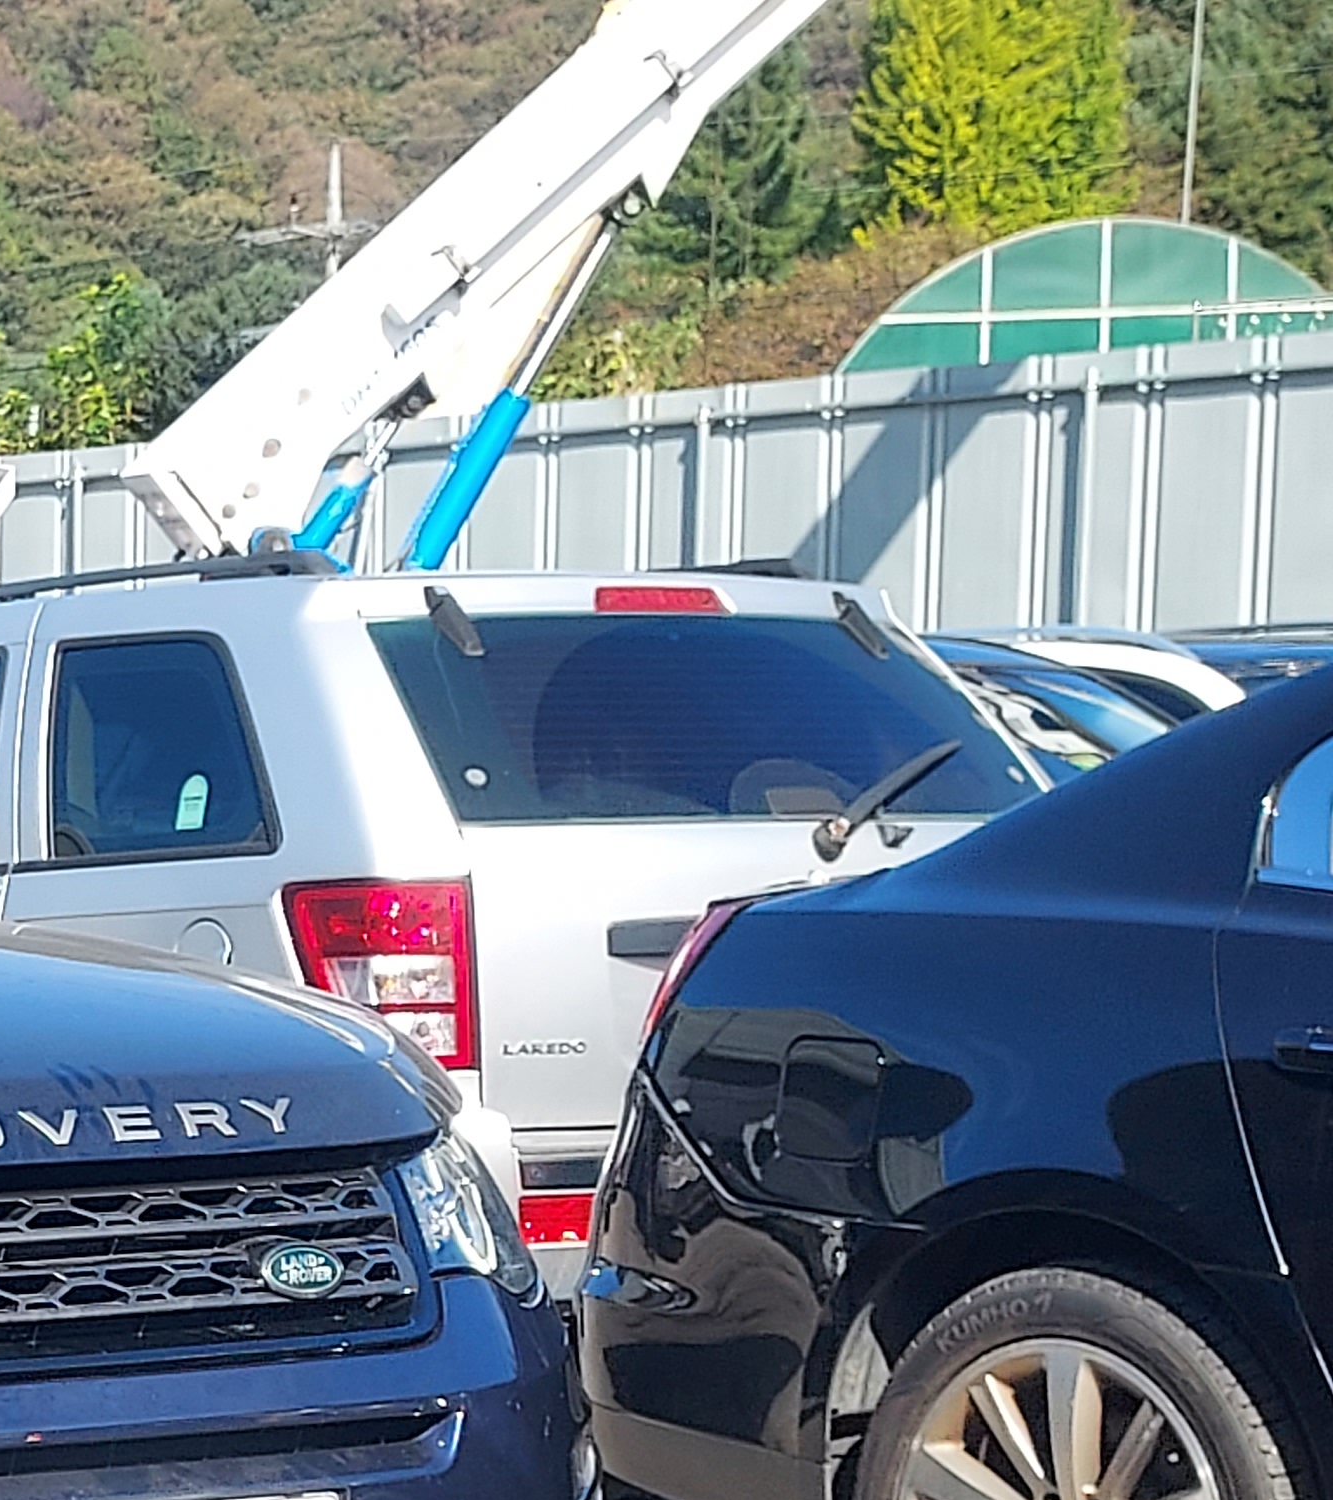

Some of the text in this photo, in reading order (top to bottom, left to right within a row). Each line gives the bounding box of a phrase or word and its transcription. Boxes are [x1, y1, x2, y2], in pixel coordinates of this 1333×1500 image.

[502, 1041, 587, 1056] LAREDO
[280, 1253, 318, 1271] LAND
[289, 1265, 333, 1284] ROVER
